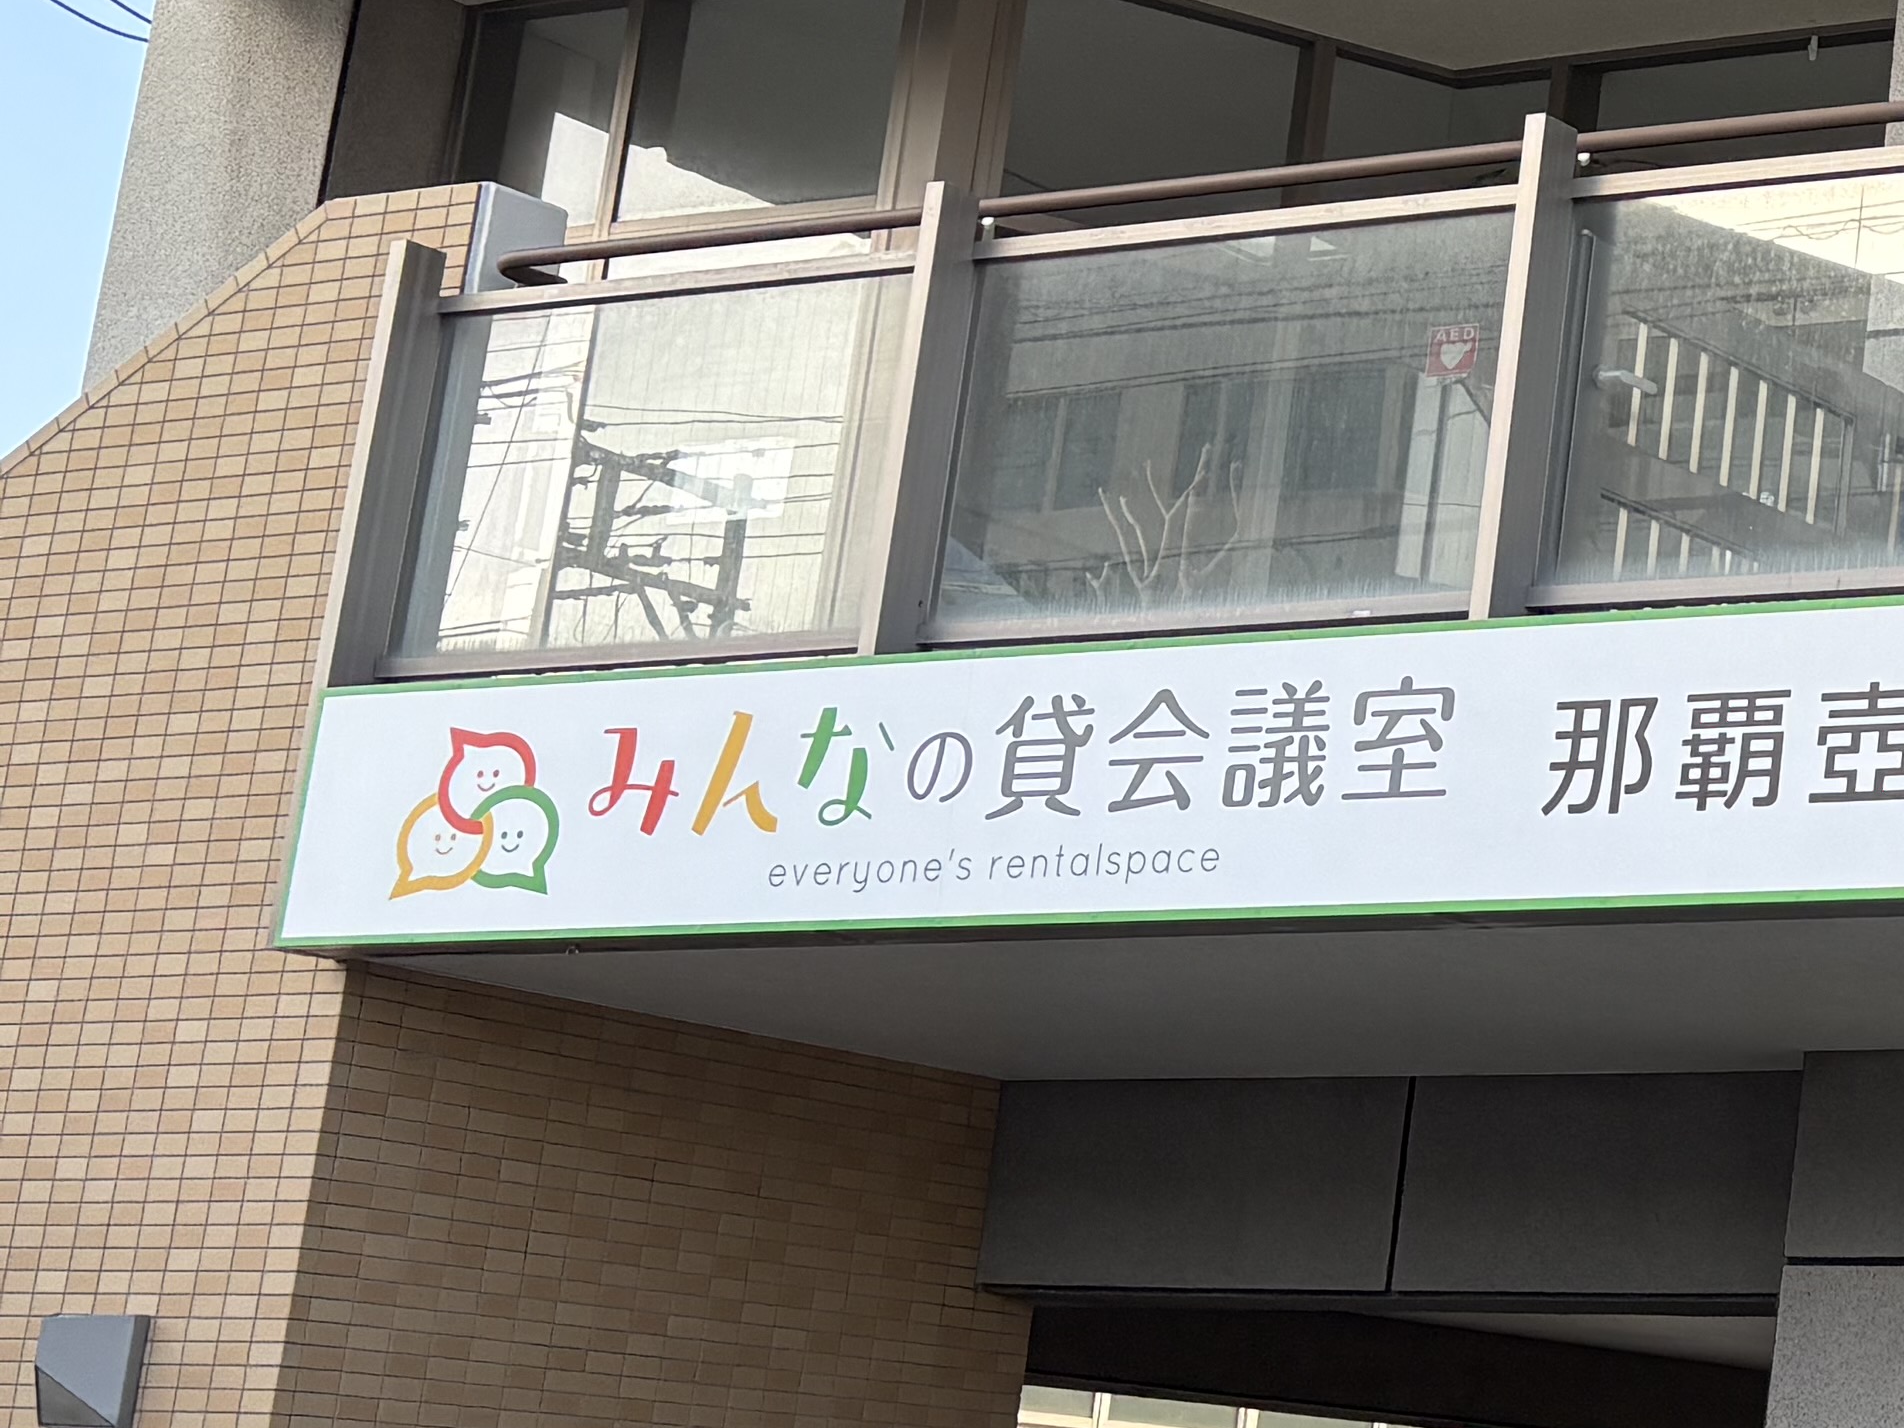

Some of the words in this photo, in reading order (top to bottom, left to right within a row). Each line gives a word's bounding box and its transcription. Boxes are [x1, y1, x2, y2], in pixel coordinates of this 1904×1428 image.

[588, 675, 1456, 836] みんなの貸会議室
[768, 847, 974, 893] everyone's
[987, 843, 1222, 881] rentalspace
